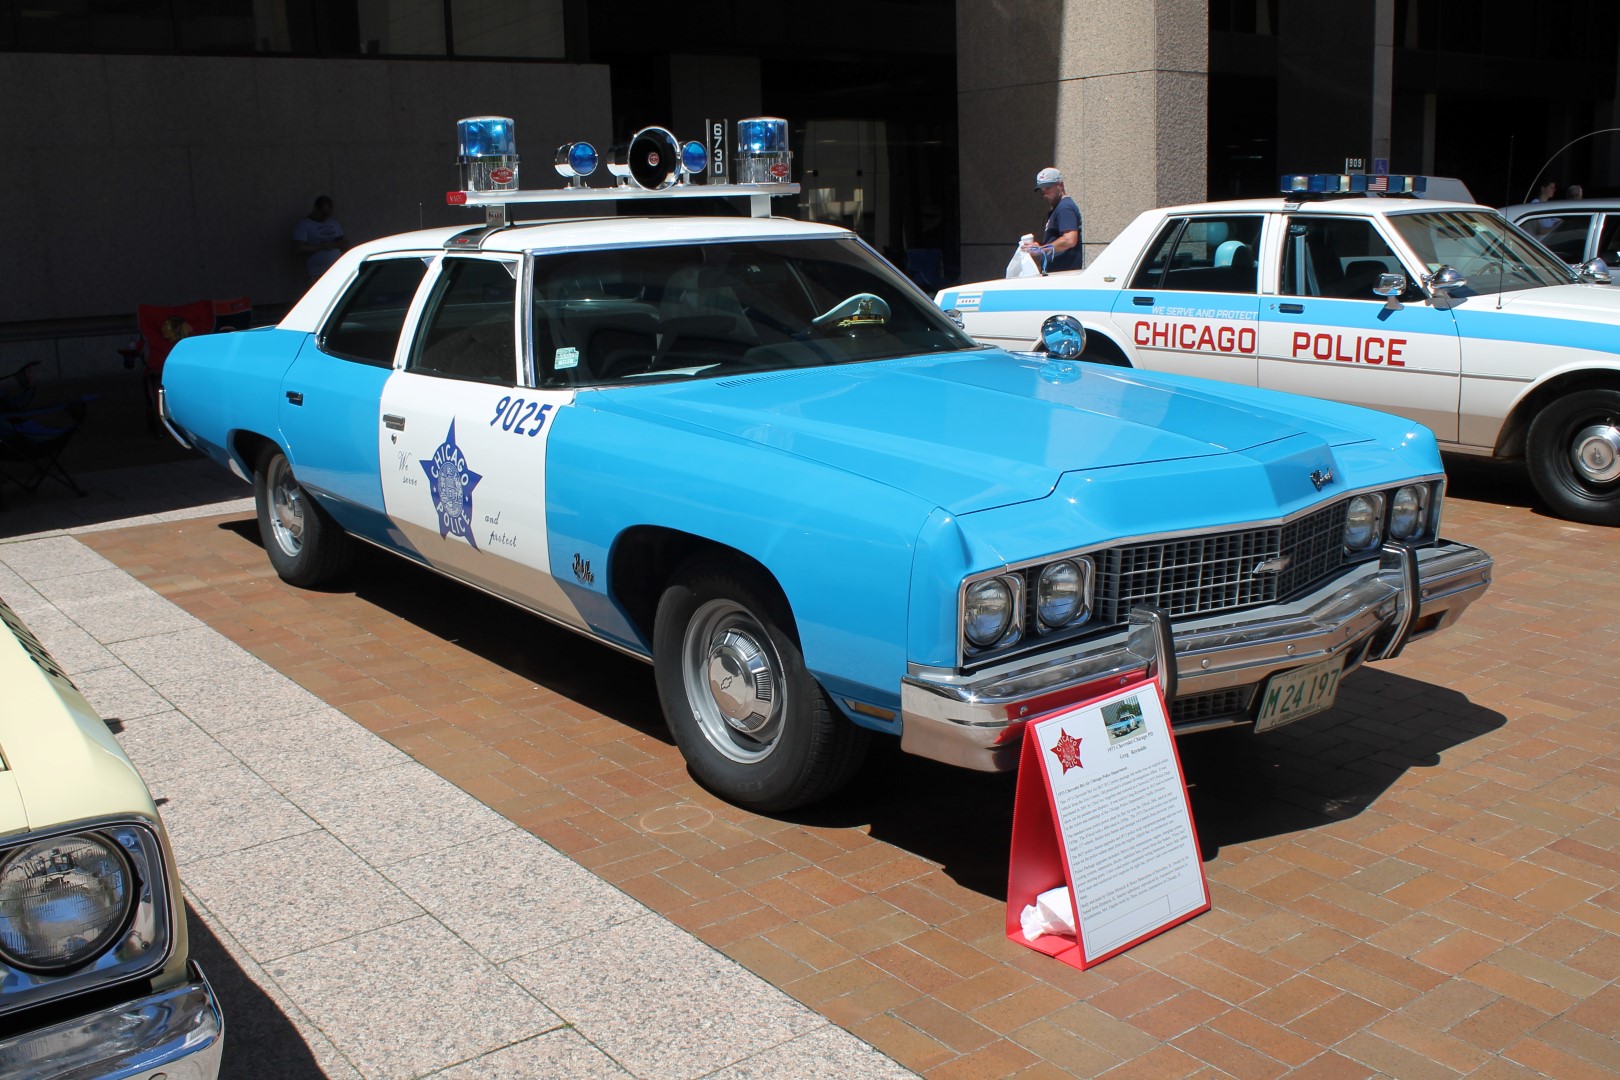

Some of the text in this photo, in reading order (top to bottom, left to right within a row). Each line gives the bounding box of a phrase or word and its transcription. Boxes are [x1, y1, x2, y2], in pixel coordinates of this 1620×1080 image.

[713, 123, 723, 174] 6730
[1349, 159, 1362, 168] 909
[1152, 305, 1258, 321] WE SERVE AND PROTECT
[1134, 320, 1407, 367] CHICAGO POLICE
[490, 396, 553, 438] 9025
[397, 451, 413, 472] We
[431, 444, 469, 486] CHICAGO
[402, 475, 418, 487] serve
[437, 501, 470, 535] POLICE
[485, 511, 501, 526] and
[488, 530, 518, 547] protect
[1057, 735, 1078, 752] CHICAGO
[1061, 755, 1080, 768] POLICE
